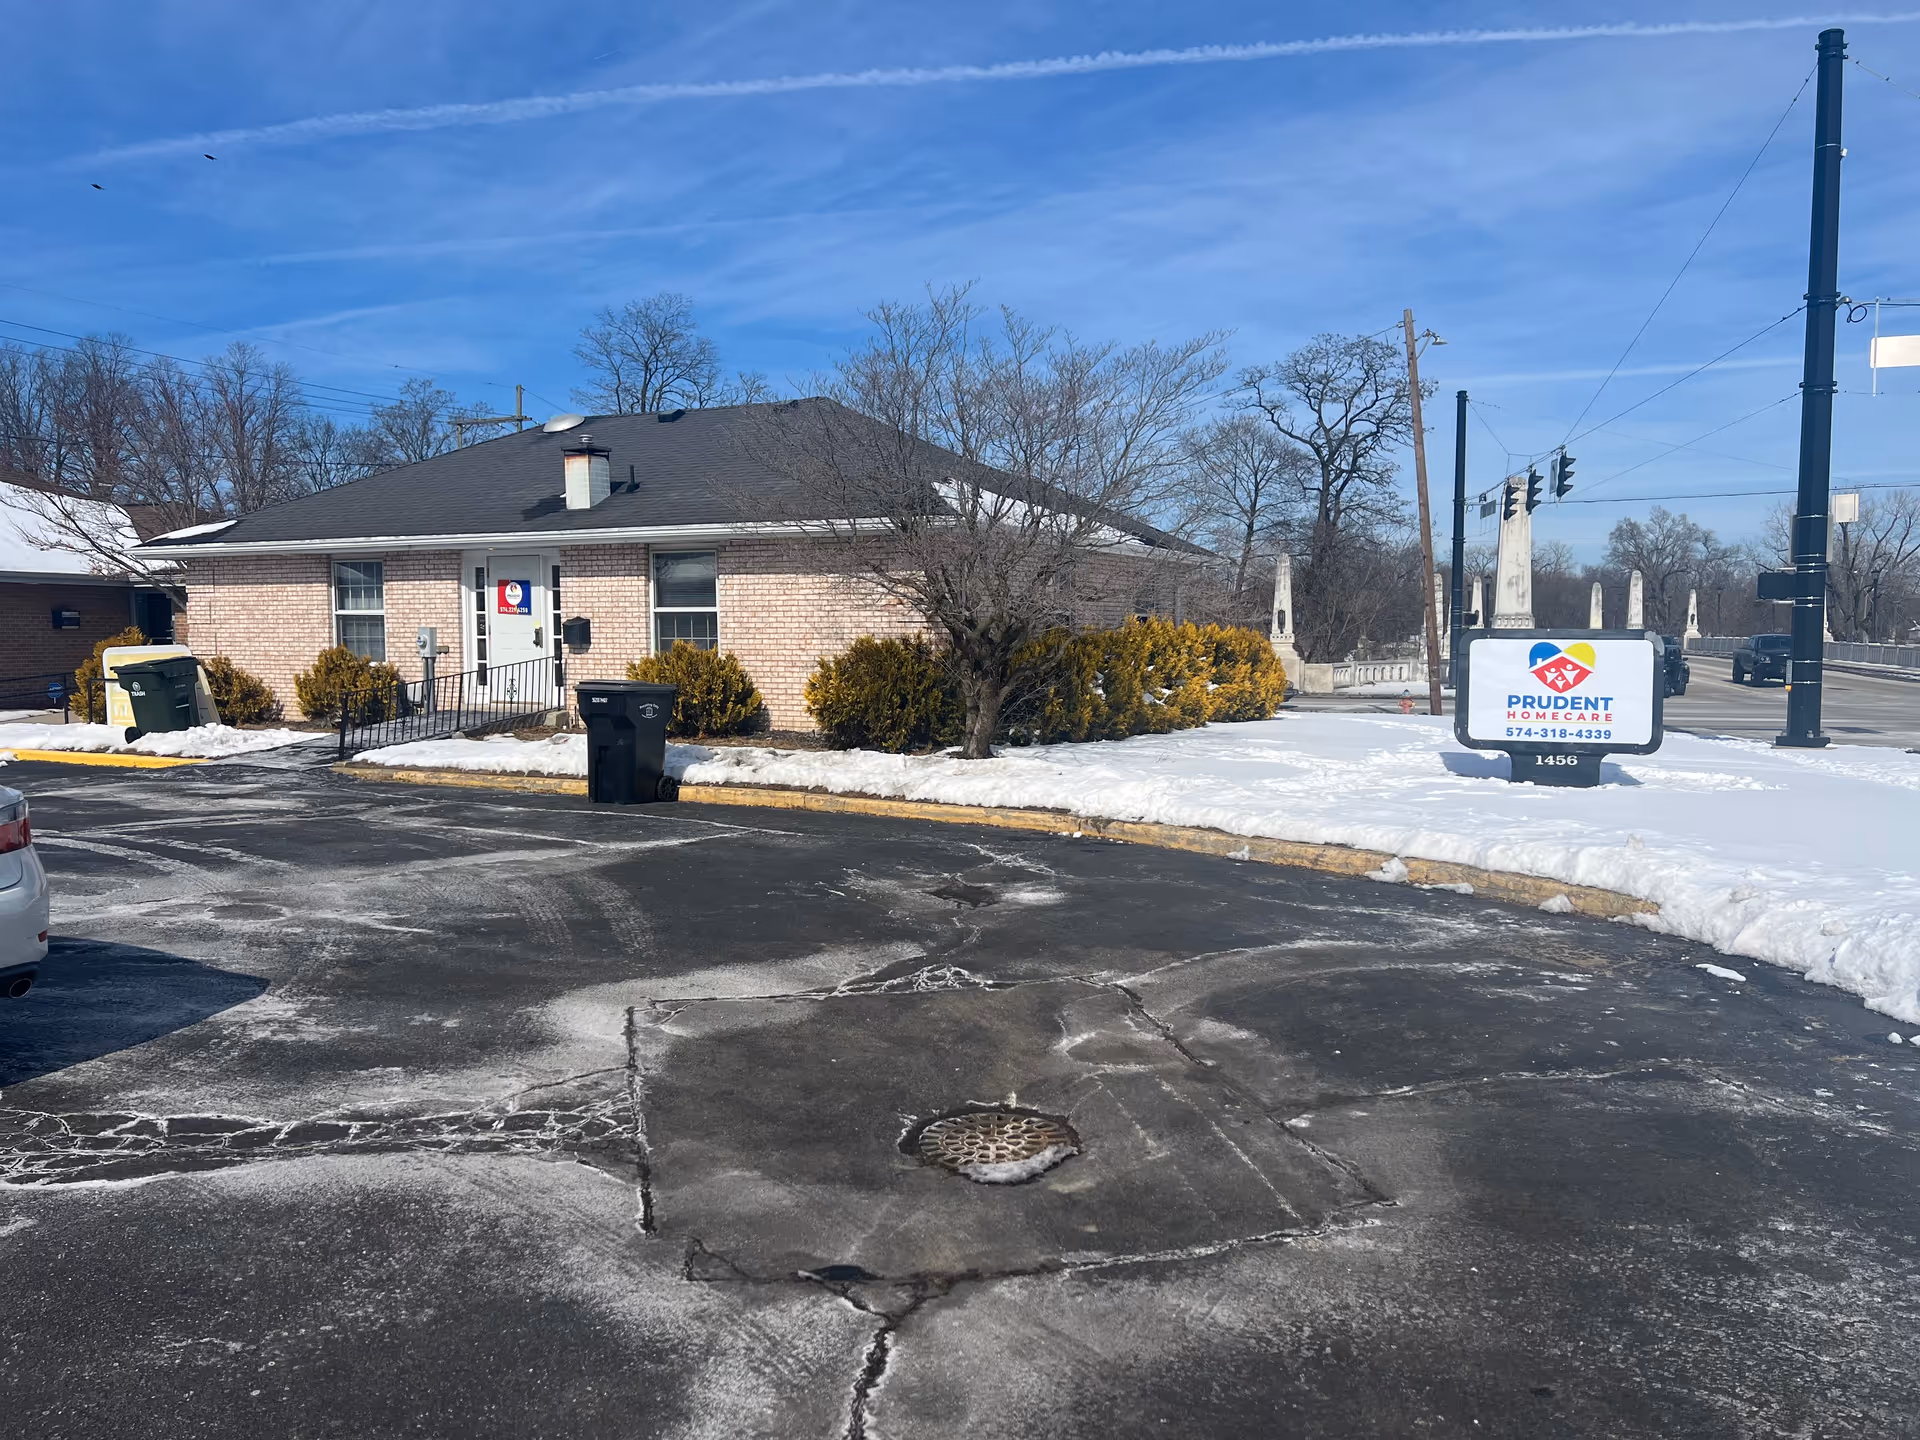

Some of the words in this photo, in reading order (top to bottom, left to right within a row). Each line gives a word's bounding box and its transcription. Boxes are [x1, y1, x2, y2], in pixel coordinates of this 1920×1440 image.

[1507, 694, 1613, 711] PRUDENT
[1507, 711, 1612, 721] HOMECARE
[1506, 727, 1612, 739] 574-318-4339
[1535, 755, 1578, 766] 1456
